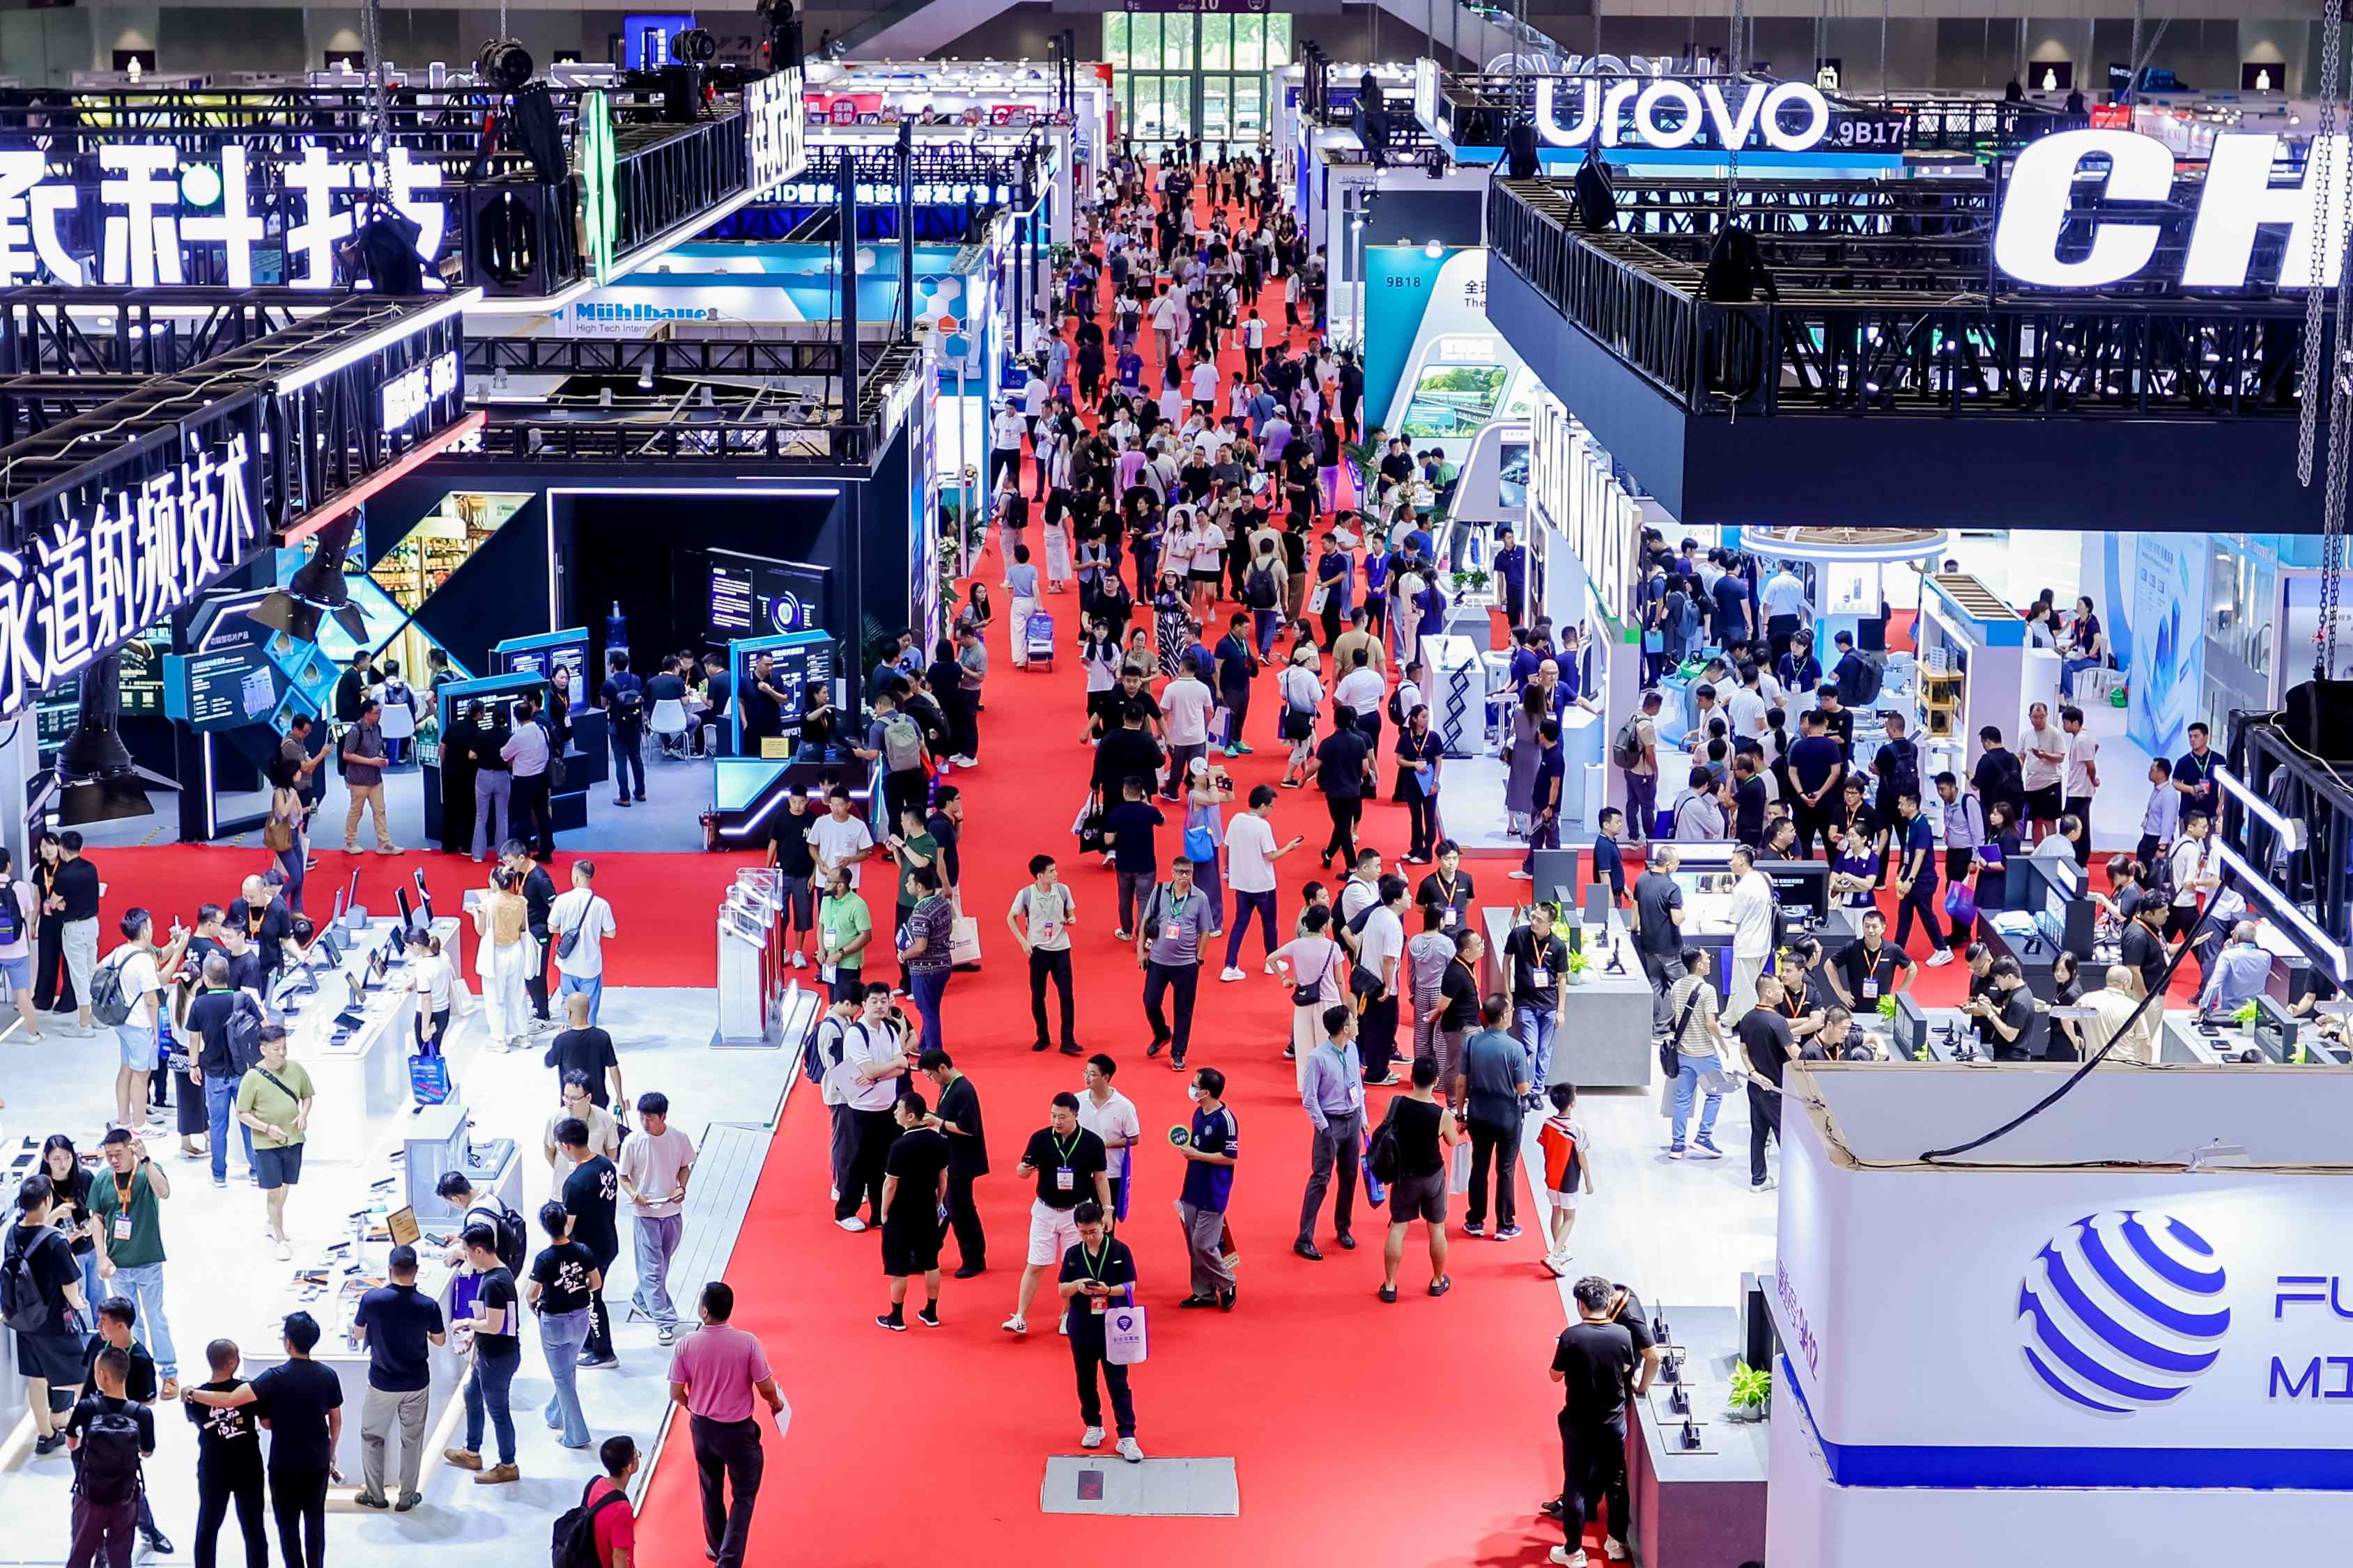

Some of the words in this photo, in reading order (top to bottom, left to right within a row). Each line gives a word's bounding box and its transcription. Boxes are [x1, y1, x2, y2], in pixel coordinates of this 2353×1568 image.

[1536, 79, 1830, 151] urovo
[1839, 123, 1901, 144] 9B17
[1996, 129, 2353, 287] CH
[1387, 277, 1421, 288] 9B18
[1464, 298, 1486, 307] The
[576, 304, 708, 320] Mühlbaue
[576, 324, 596, 334] High
[599, 324, 620, 332] Tech
